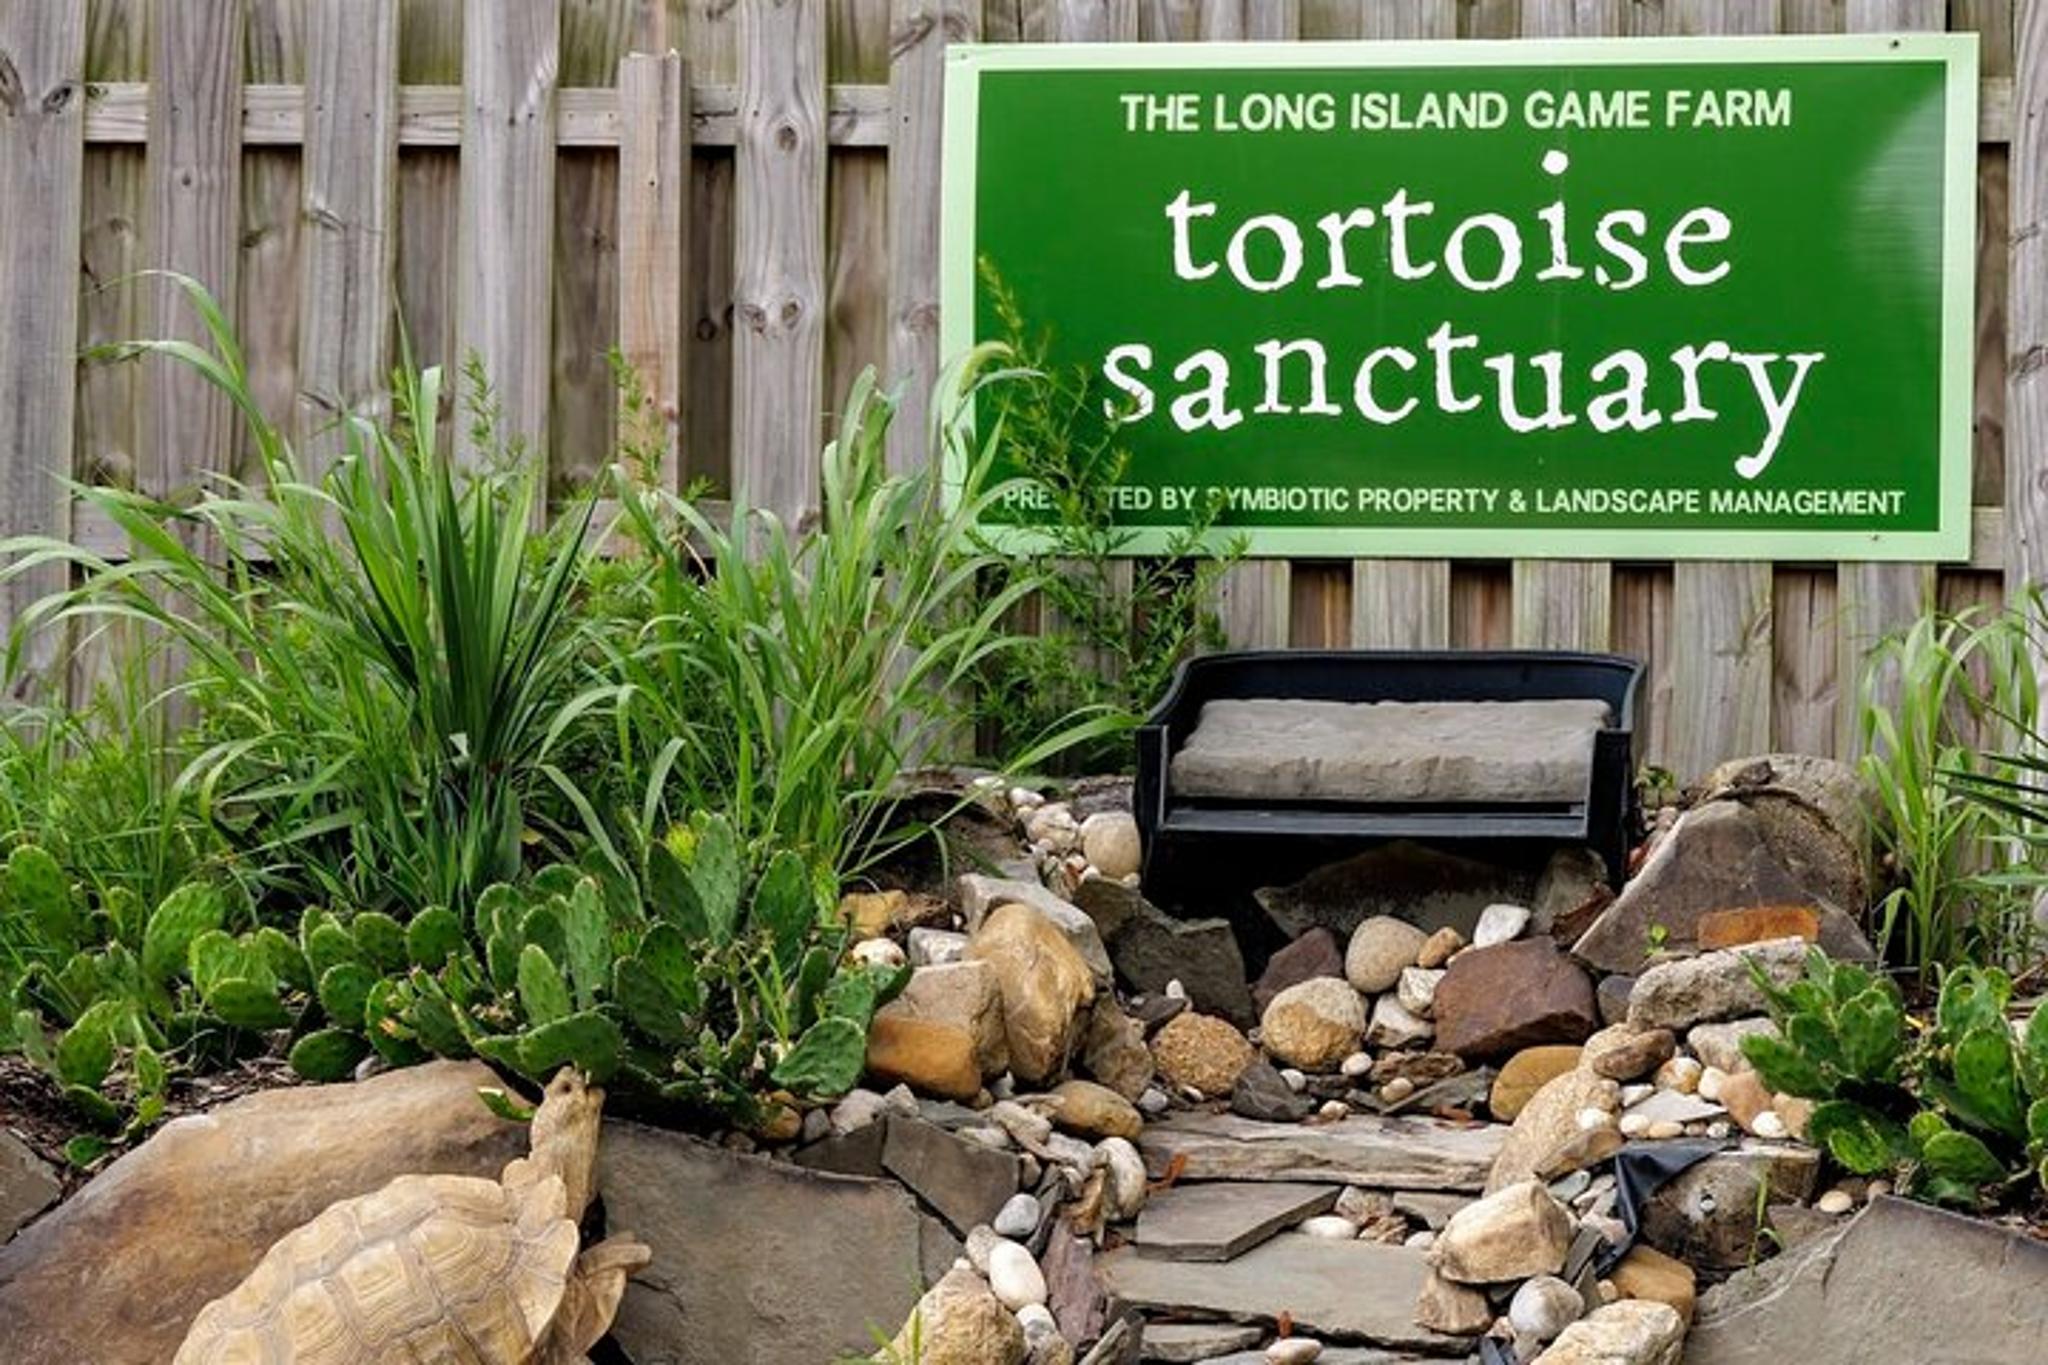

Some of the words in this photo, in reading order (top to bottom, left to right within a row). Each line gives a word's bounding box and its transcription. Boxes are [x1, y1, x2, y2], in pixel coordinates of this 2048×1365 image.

[1120, 94, 1200, 131] THE
[1215, 93, 1336, 131] LONG
[1351, 92, 1509, 130] ISLAND
[1524, 91, 1651, 129] GAME
[1665, 90, 1792, 127] FARM
[1165, 149, 1733, 292] tortoise
[1103, 321, 1825, 479] sanctuary
[1002, 487, 1153, 510] PRETED
[1161, 487, 1197, 510] BY
[1357, 488, 1500, 512] PROPERTY
[1508, 489, 1527, 513] &
[1536, 489, 1700, 514] LANDSCAPE
[1709, 490, 1906, 515] MANAGEMENT
